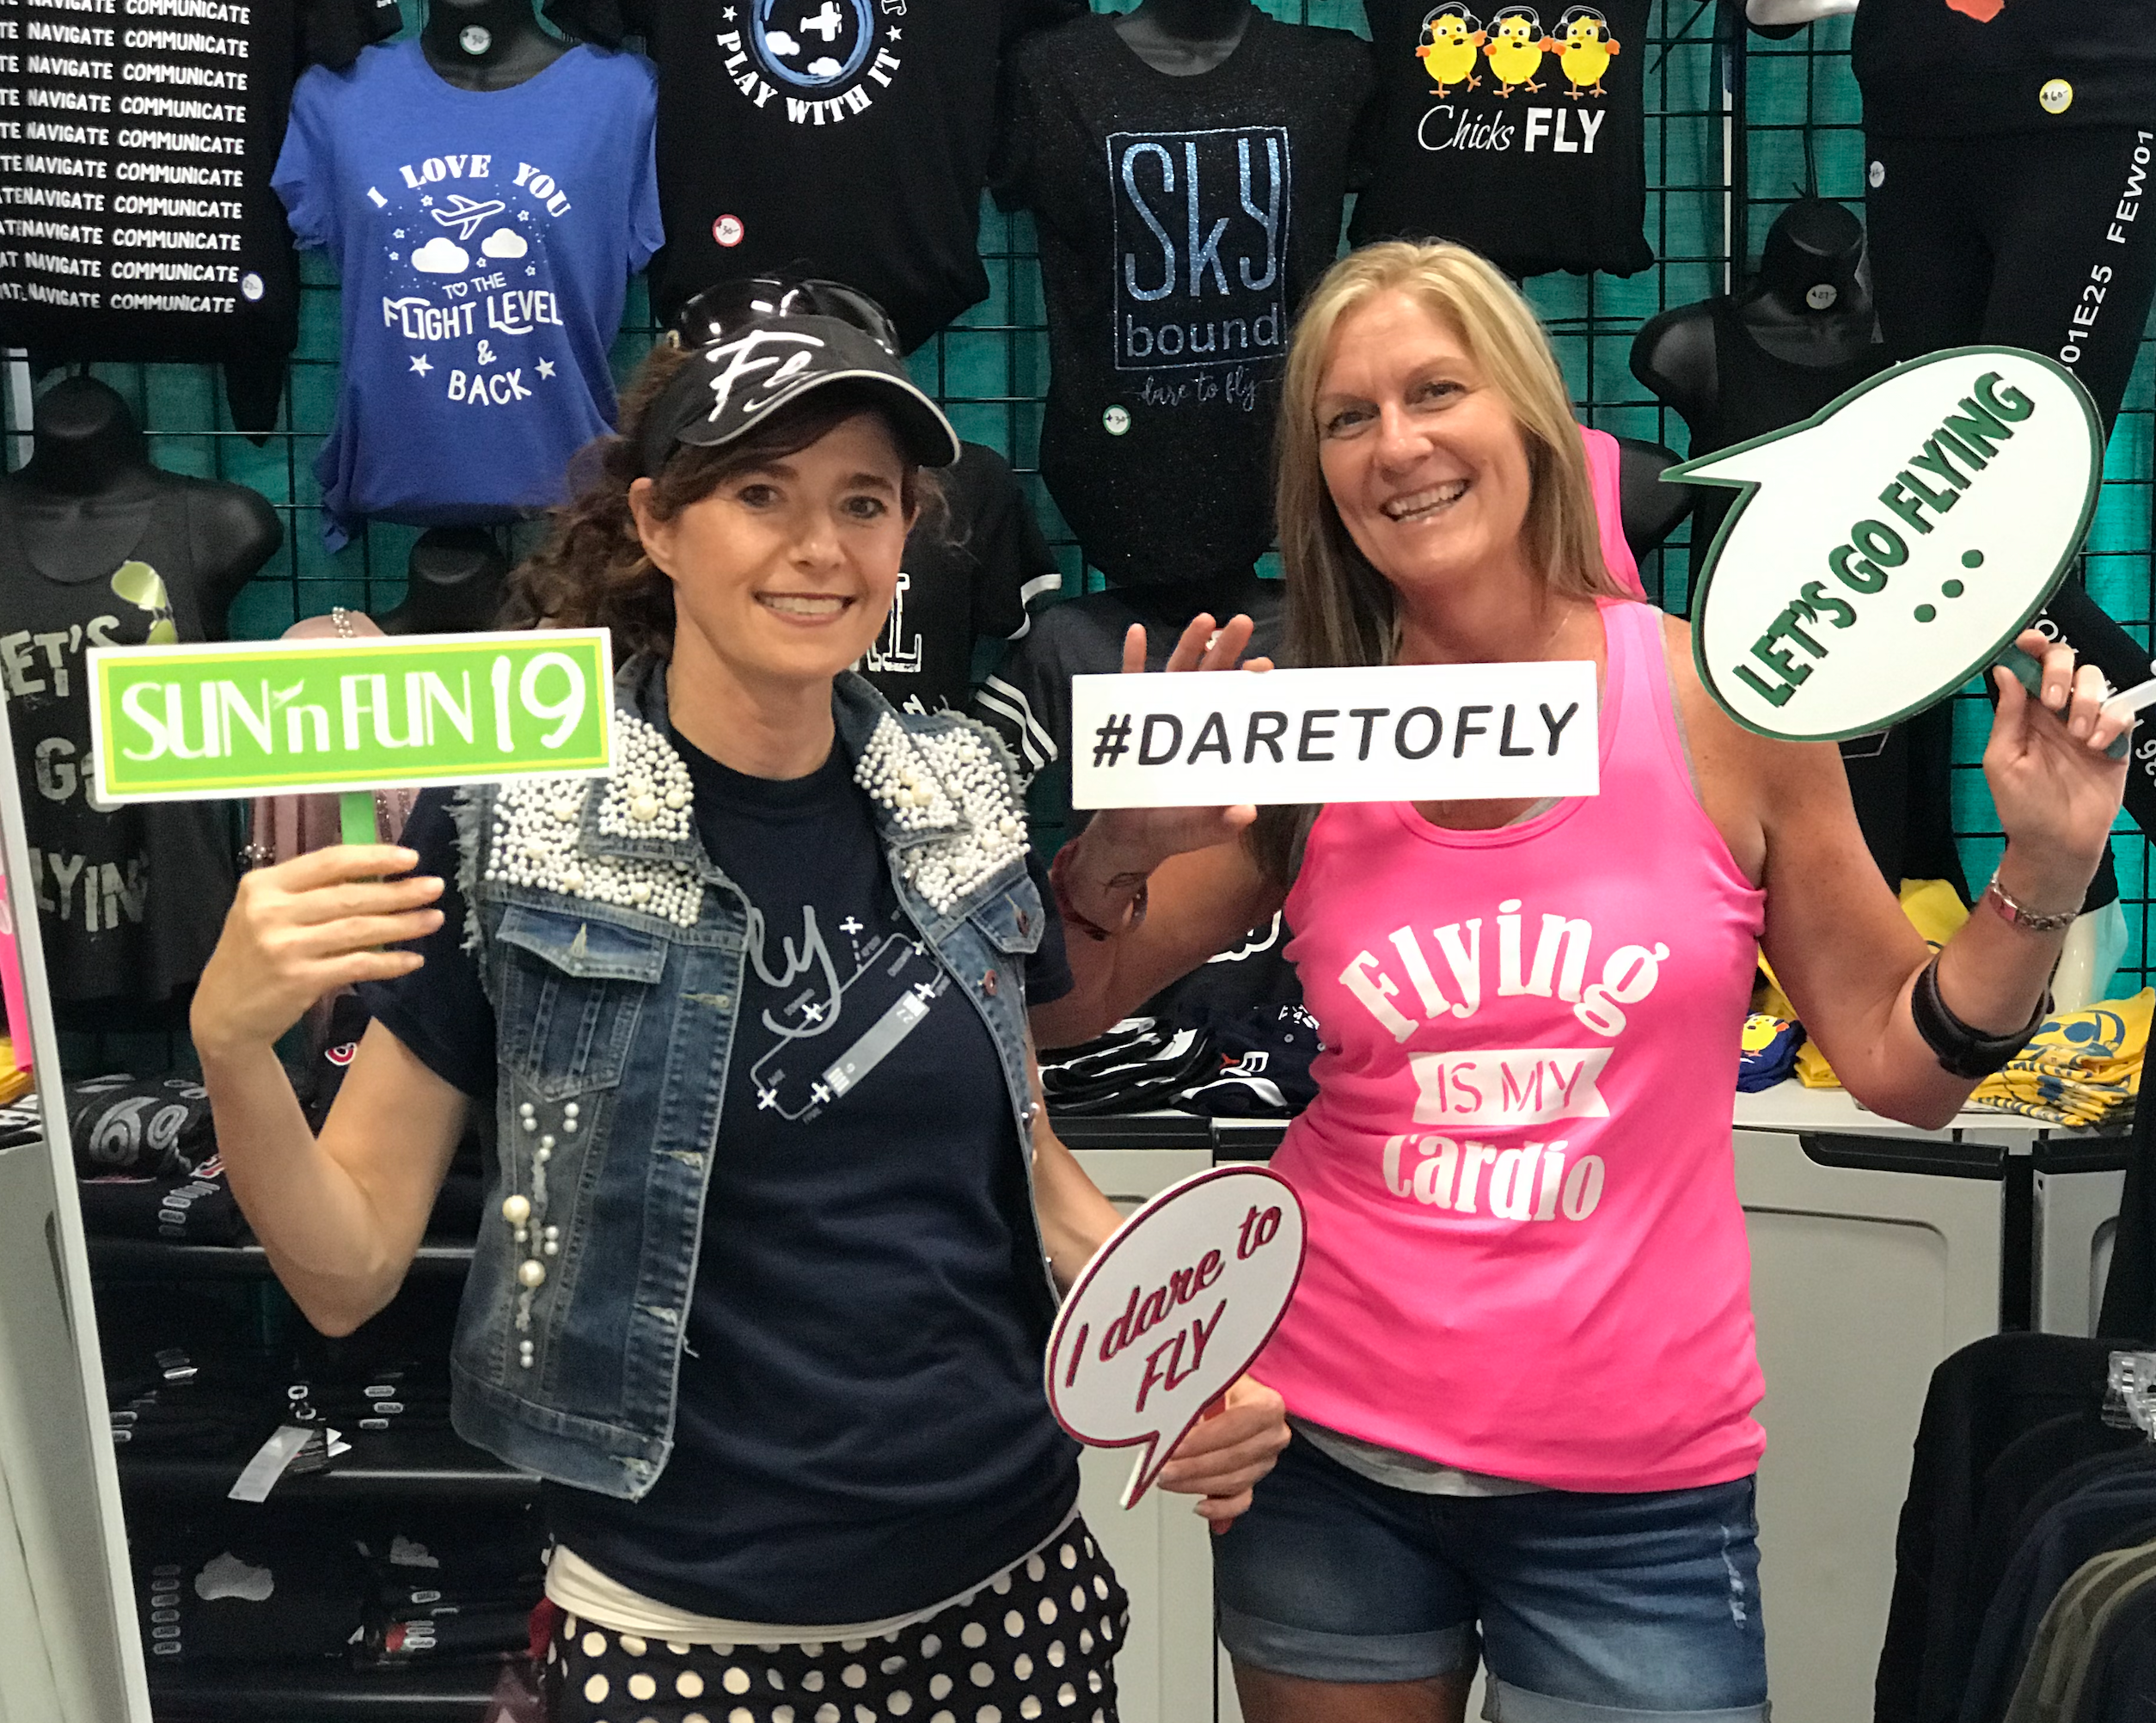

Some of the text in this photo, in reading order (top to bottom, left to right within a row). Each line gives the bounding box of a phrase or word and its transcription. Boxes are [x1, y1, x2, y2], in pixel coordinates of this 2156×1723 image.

[126, 0, 250, 25] COMMUNICATE
[28, 21, 115, 46] NAVIGATE
[125, 30, 248, 58] COMMUNICATE
[28, 55, 113, 80] NAVIGATE
[123, 64, 248, 90] COMMUNICATE
[717, 30, 901, 126] PLAY WITH IT
[27, 89, 112, 113] NAVIGATE
[120, 96, 246, 123] COMMUNICATE
[1418, 105, 1606, 154] Chicks FLY
[26, 121, 109, 146] NAVIGATE
[119, 129, 244, 156] COMMUNICATE
[25, 155, 107, 179] NAVIGATE
[116, 162, 243, 187] COMMUNICATE
[367, 154, 572, 218] I LOVE YOU
[2107, 130, 2154, 244] FEW01
[23, 187, 106, 212] NAVIGATE
[113, 195, 242, 218] COMMUNICATE
[22, 219, 104, 245] NAVIGATE
[112, 229, 241, 251] COMMUNICATE
[24, 251, 101, 278] NAVIGATE
[111, 261, 239, 283] COMMUNICATE
[442, 272, 507, 300] TO THE
[28, 283, 101, 308] NAVIGATE
[110, 293, 236, 313] COMMUNICATE
[383, 291, 564, 341] FLIGHT LEVEL
[2060, 264, 2113, 373] 01E25
[477, 340, 497, 366] &
[1127, 303, 1279, 357] bound
[448, 368, 532, 406] BACK
[1194, 371, 1220, 402] to
[1225, 365, 1257, 412] fly
[1732, 371, 2036, 708] LET'S GO FLYING
[340, 669, 475, 751] FUN
[491, 652, 586, 754] 19
[1092, 702, 1579, 769] #DARETOFLY
[1338, 898, 1670, 1044] Flying
[1437, 1060, 1585, 1113] IS MY
[1382, 1135, 1605, 1222] Cardio
[1065, 1205, 1283, 1389] I dare to
[1136, 1298, 1228, 1413] FLY
